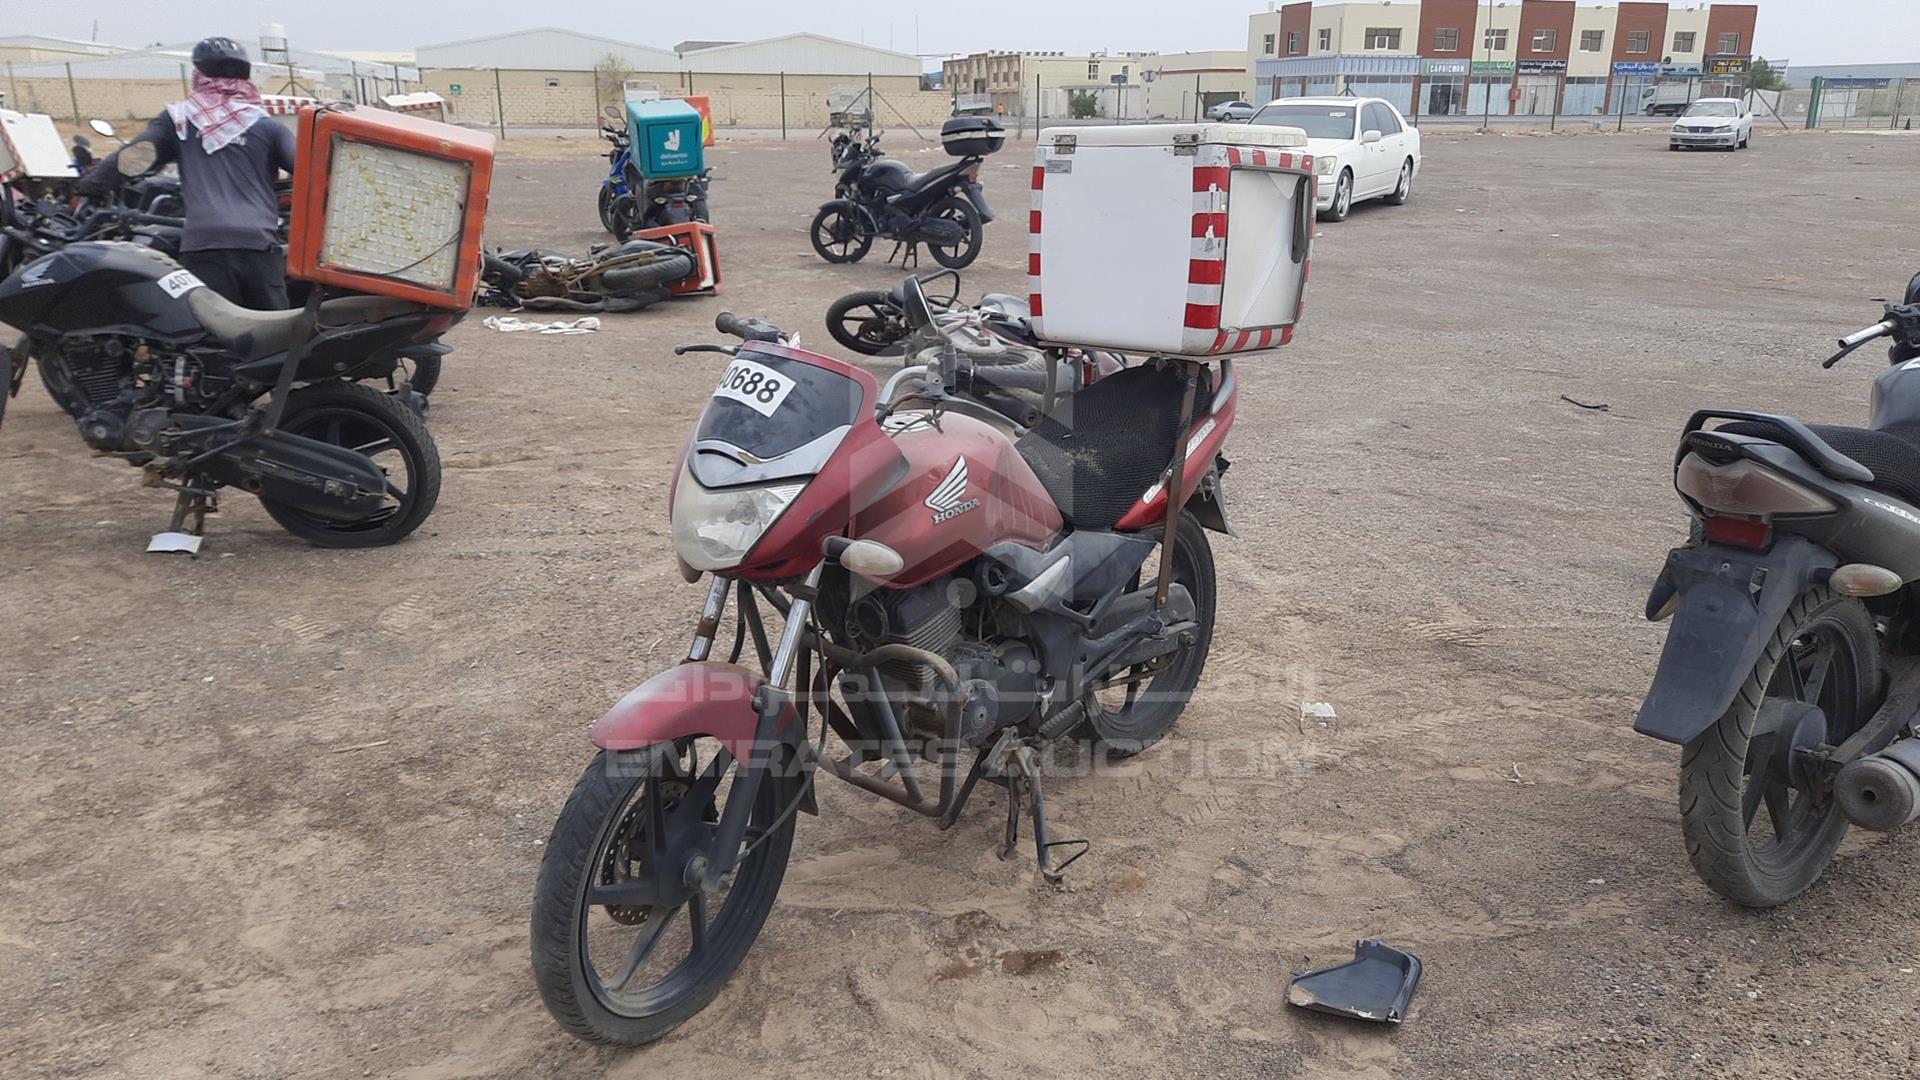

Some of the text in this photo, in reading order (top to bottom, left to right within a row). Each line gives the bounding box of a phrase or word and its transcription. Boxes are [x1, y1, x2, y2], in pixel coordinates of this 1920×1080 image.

[21, 278, 56, 288] HONDA
[720, 366, 781, 403] 0688
[1691, 437, 1733, 452] HONDA
[931, 497, 981, 525] HONDA
